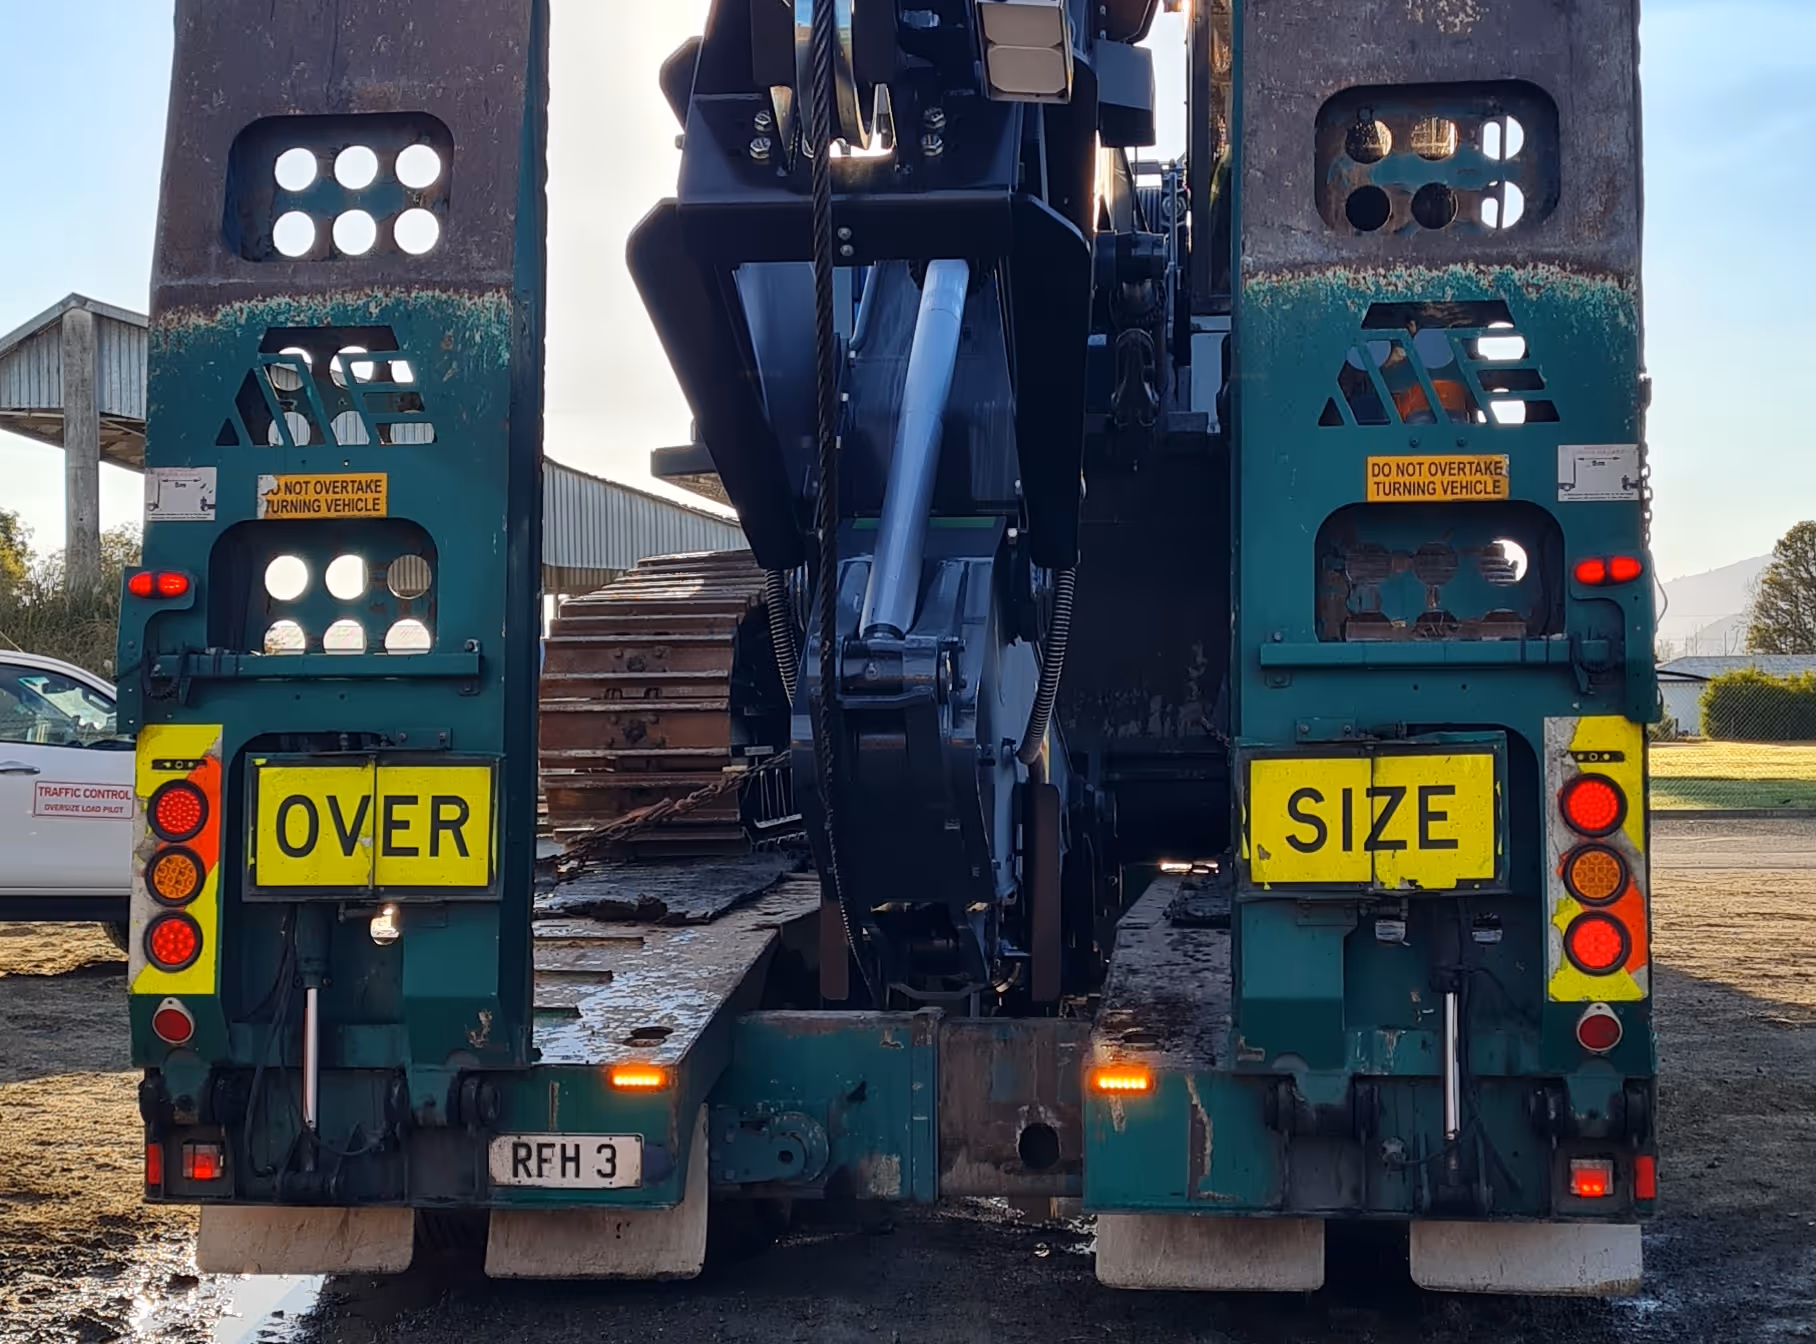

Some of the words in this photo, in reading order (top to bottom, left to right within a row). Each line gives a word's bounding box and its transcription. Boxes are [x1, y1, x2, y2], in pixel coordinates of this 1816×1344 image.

[1372, 462, 1392, 477] DO
[1396, 462, 1424, 477] NOT
[1428, 461, 1503, 477] OVERTAKE
[284, 481, 311, 495] NOT
[313, 479, 382, 495] OVERTAKE
[1374, 481, 1436, 496] TURNING
[1441, 480, 1501, 495] VEHICLE
[265, 498, 321, 514] TURNING
[325, 497, 380, 512] VEHICLE
[38, 786, 81, 798] TRAFFIC
[83, 788, 131, 800] CONTROL
[44, 803, 80, 812] OVERSIZE
[82, 805, 101, 813] LOAD
[103, 806, 124, 814] PILOT
[276, 794, 470, 858] OVER
[1286, 784, 1458, 853] SIZE
[512, 1143, 580, 1178] RFH
[596, 1144, 616, 1178] 3
